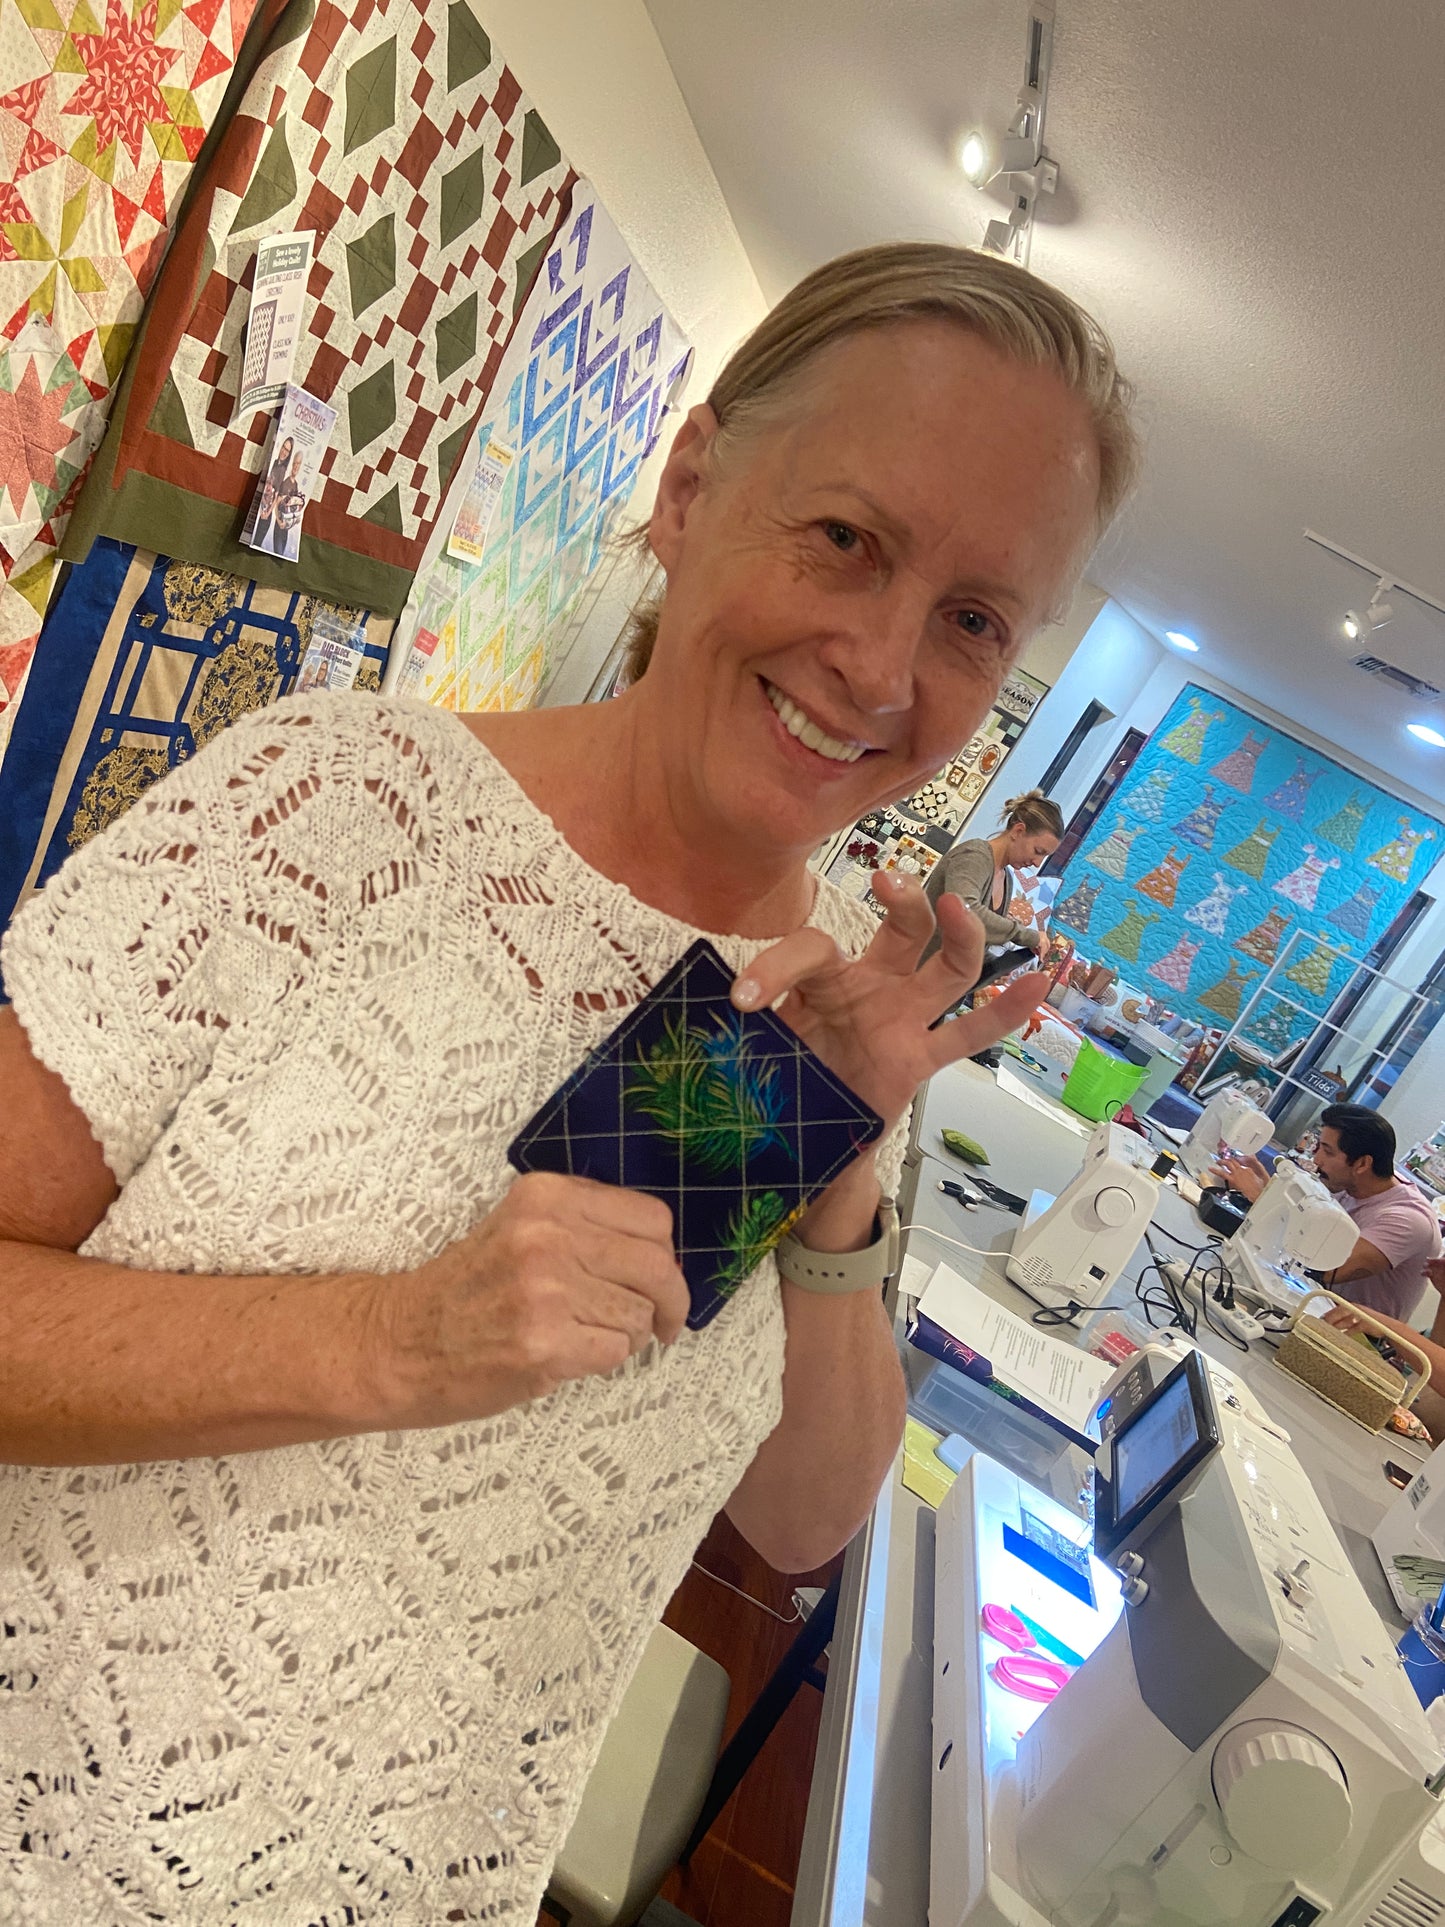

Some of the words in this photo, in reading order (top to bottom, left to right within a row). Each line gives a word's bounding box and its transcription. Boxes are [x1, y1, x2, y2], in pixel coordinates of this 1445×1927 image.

[275, 249, 285, 257] Sew
[294, 403, 326, 432] CHRISTMAS
[321, 641, 336, 658] BIG
[886, 811, 914, 832] FALL
[1308, 1073, 1331, 1092] Tilda
